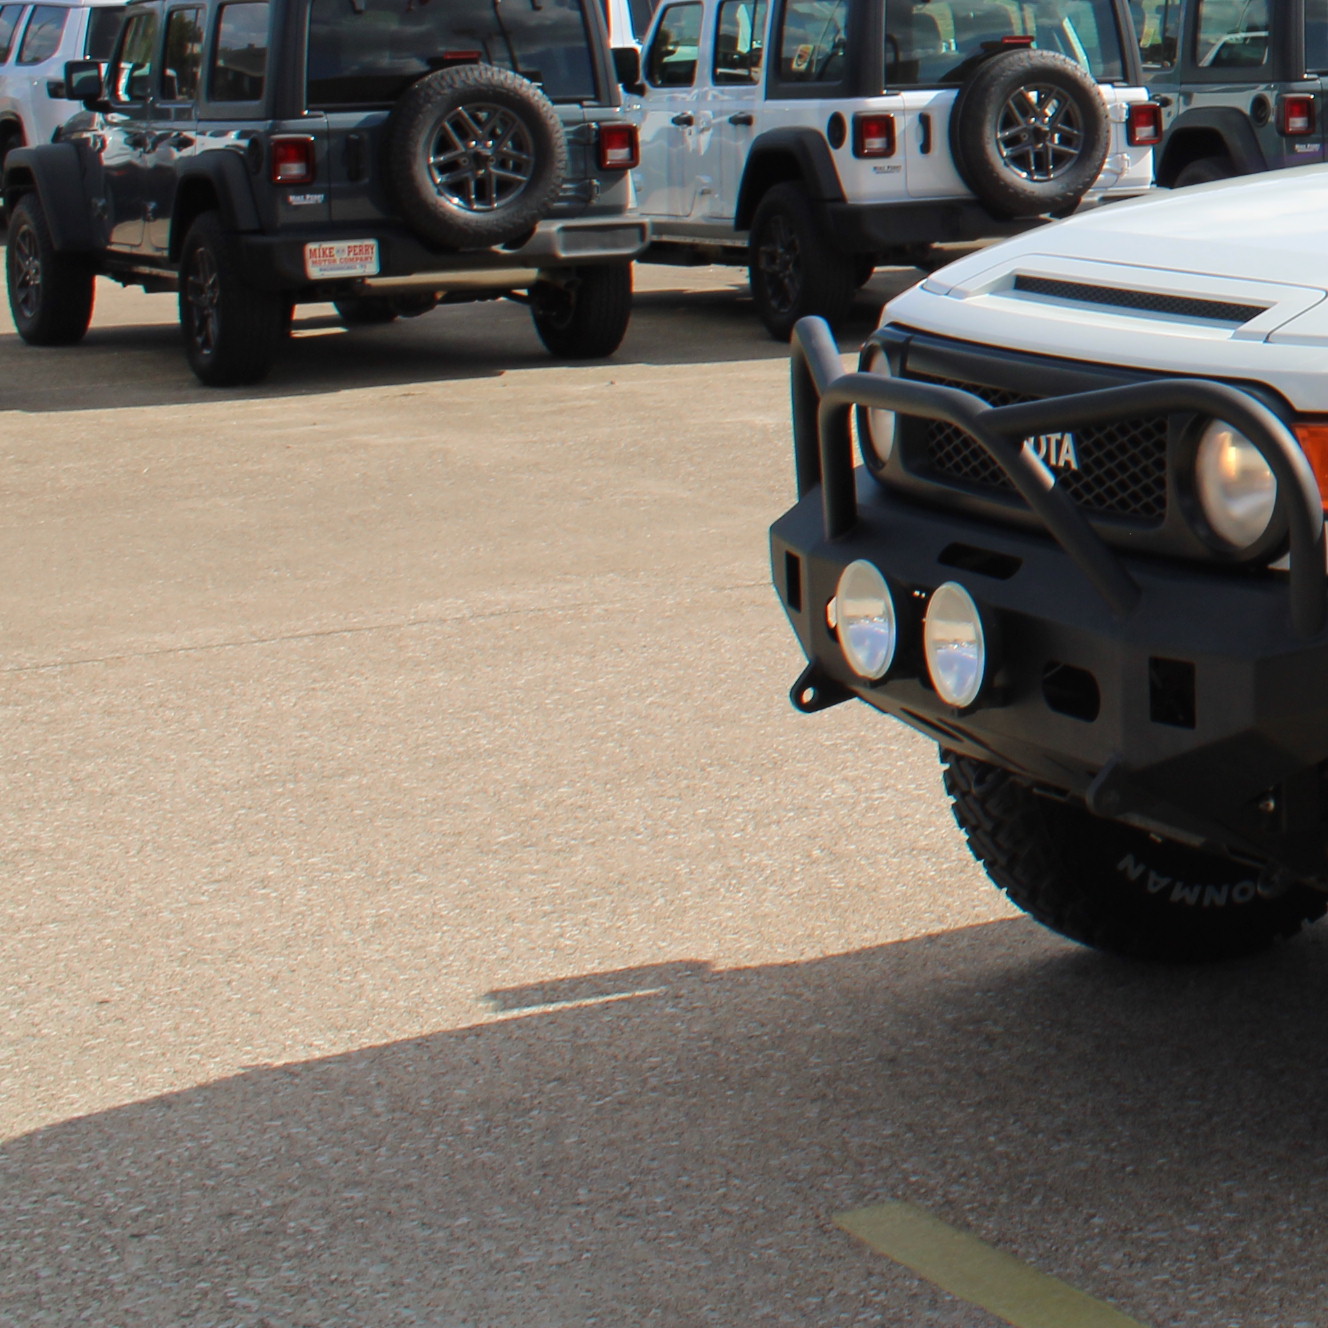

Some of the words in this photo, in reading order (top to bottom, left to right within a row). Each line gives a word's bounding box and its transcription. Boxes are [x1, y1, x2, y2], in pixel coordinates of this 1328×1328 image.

[309, 246, 336, 259] MIKE
[347, 243, 375, 257] PERRY
[339, 255, 374, 265] COMPANY
